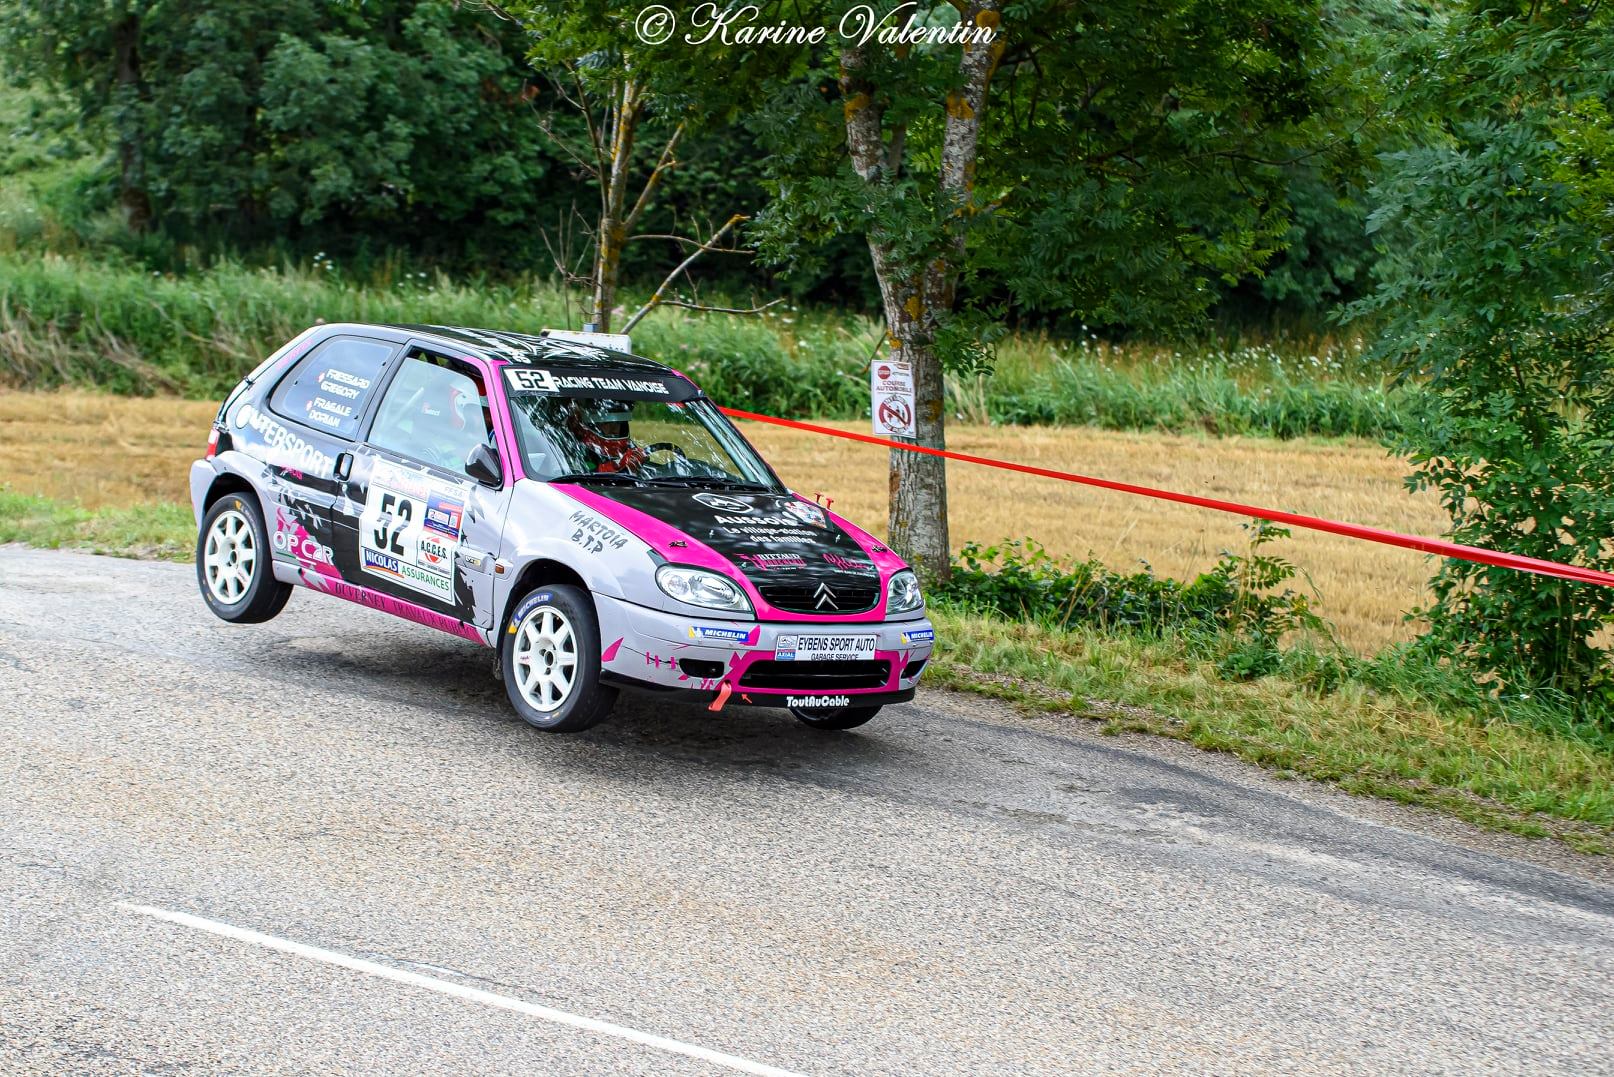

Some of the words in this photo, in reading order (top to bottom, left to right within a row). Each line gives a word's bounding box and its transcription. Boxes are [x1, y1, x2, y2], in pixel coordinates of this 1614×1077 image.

[514, 371, 549, 389] 52
[553, 376, 592, 388] RACING
[594, 377, 625, 390] TEAM
[626, 380, 670, 395] VANOISE
[320, 381, 360, 399] GREGORY
[308, 409, 341, 428] DORIAN
[373, 493, 412, 556] 52
[365, 549, 398, 572] NICOLAS
[401, 565, 450, 591] ASSURANCES
[704, 628, 746, 639] MICHELIN
[798, 637, 828, 651] EYBENS
[829, 638, 853, 651] SPORT
[854, 638, 875, 651] AUTO
